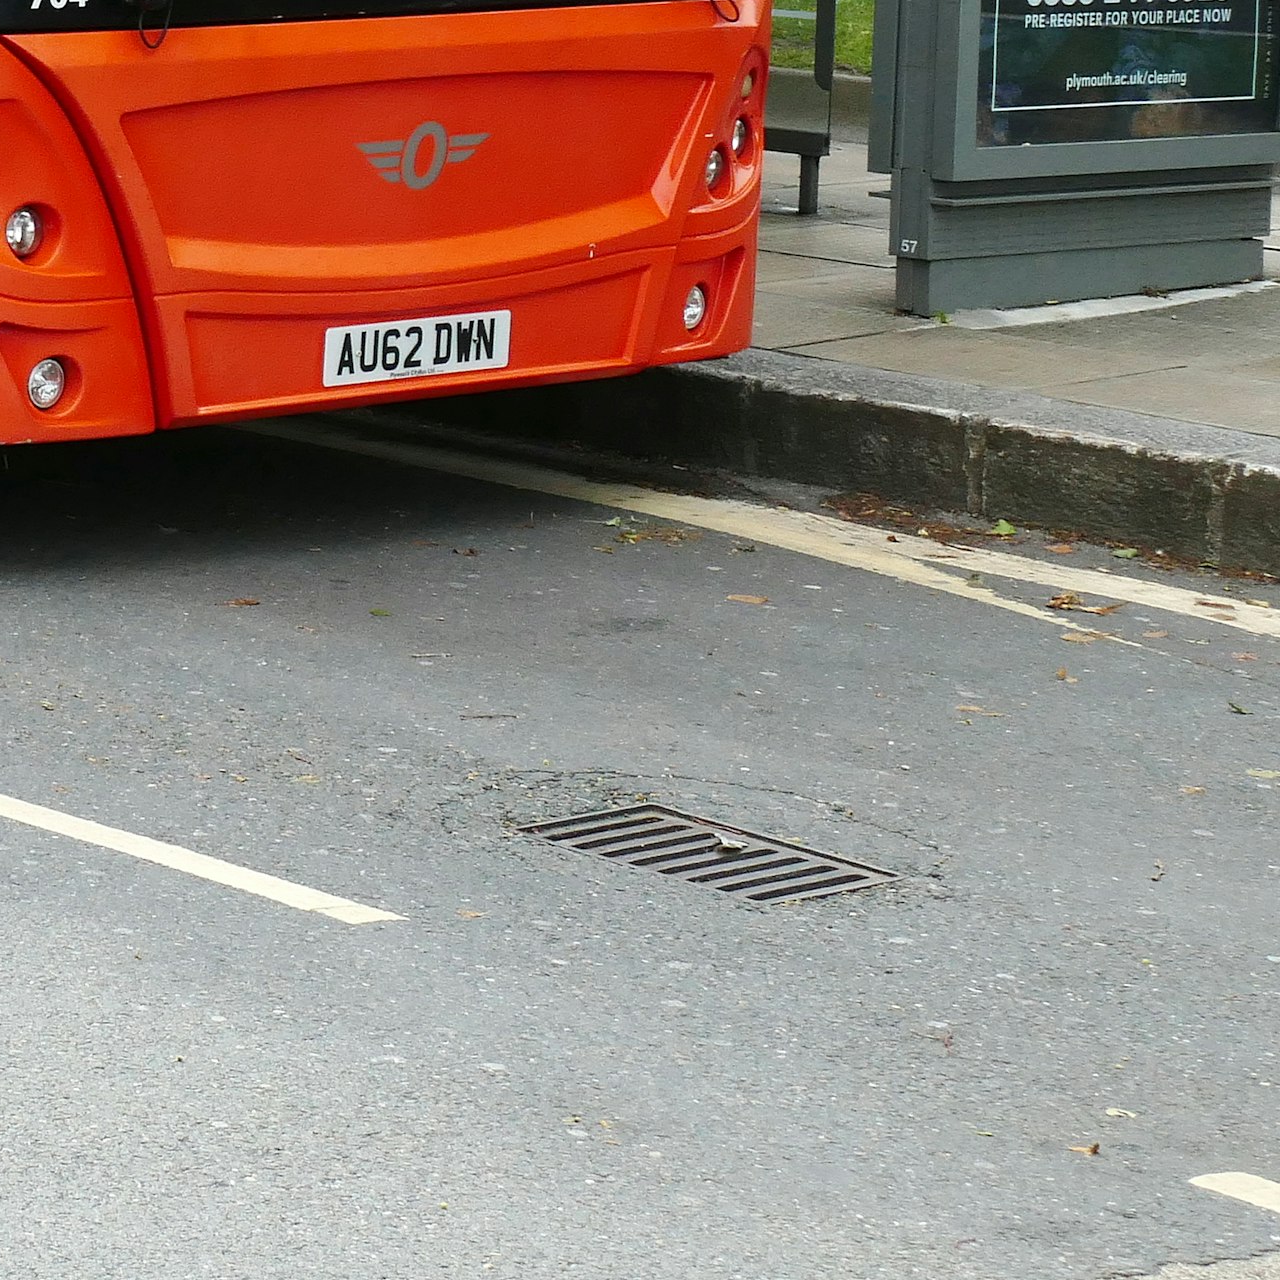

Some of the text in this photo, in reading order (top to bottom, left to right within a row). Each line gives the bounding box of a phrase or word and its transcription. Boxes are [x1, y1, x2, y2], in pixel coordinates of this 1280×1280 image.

[1024, 8, 1232, 29] PRE-REGISTER FOR YOUR PLACE NOW
[1066, 69, 1187, 92] plymouth.ac.uk/clearing
[901, 239, 918, 253] 57
[337, 318, 496, 376] AU62 DWN
